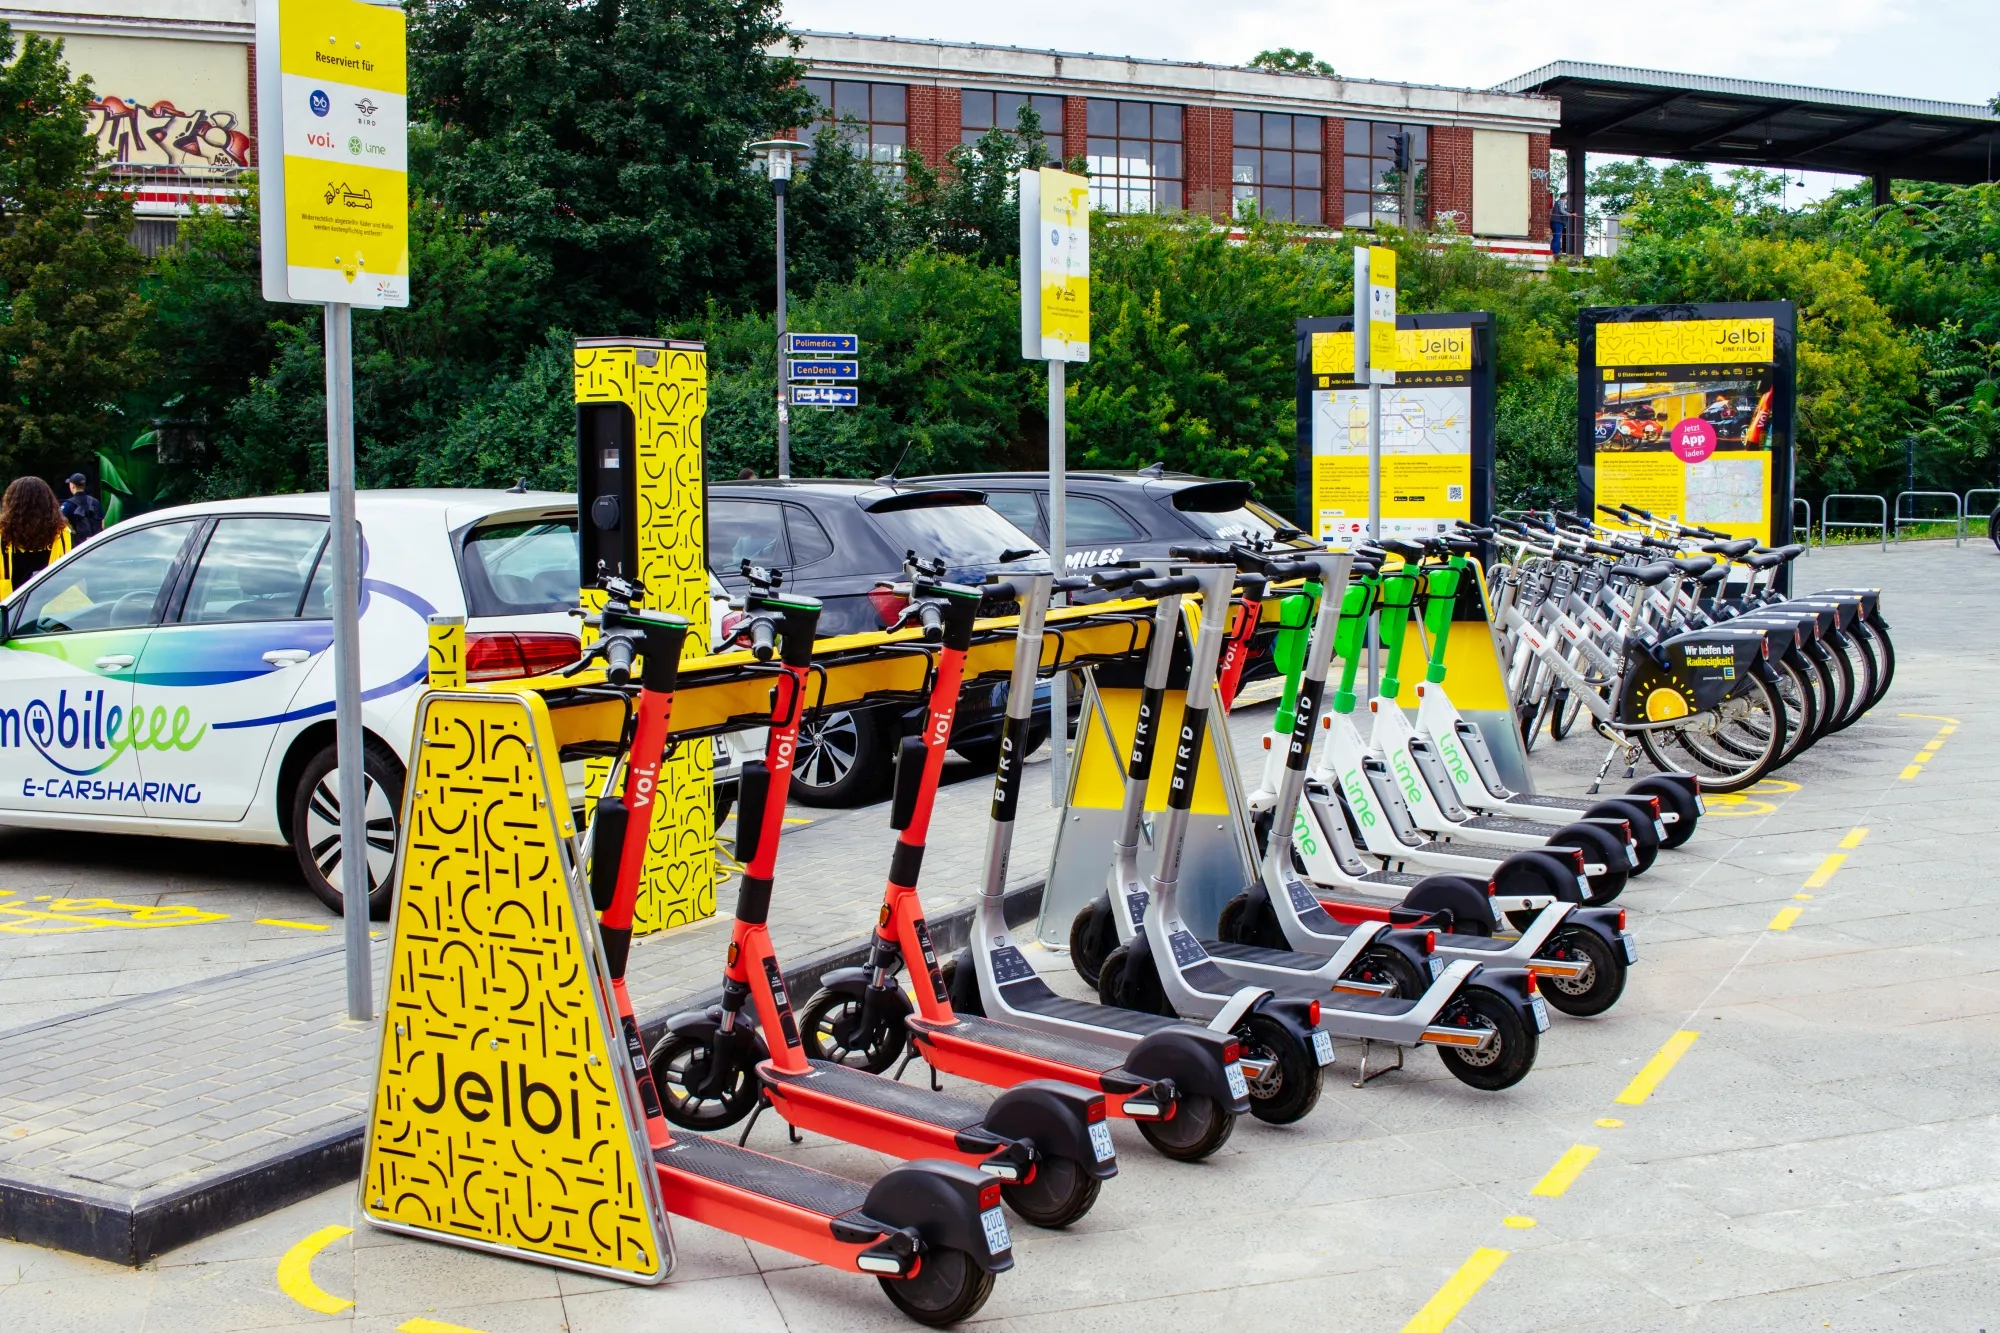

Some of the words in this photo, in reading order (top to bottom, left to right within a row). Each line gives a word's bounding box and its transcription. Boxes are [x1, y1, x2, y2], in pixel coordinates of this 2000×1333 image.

[315, 51, 360, 70] Reserviert
[362, 60, 375, 72] für
[357, 118, 377, 127] BIRD
[307, 132, 335, 149] voi.
[795, 339, 837, 348] Polimedica
[1419, 337, 1464, 353] Jelbi
[1715, 327, 1766, 345] Jelbi
[796, 365, 837, 375] CenDenta
[1683, 424, 1701, 433] Jetzt
[1681, 433, 1705, 449] App
[1684, 448, 1705, 458] laden
[1065, 547, 1124, 570] MILES
[1222, 643, 1239, 671] voi.
[1684, 645, 1698, 656] Wir
[1698, 645, 1722, 655] helfen
[1722, 644, 1735, 655] bei
[1686, 656, 1735, 669] Radlosigkeit!
[1544, 655, 1591, 703] nextbike
[931, 707, 953, 746] voi.
[1132, 703, 1151, 763] BIRD
[1290, 695, 1313, 755] BIRD
[774, 728, 796, 771] voi.
[1172, 724, 1194, 791] BIRD
[1439, 732, 1469, 785] Lime
[993, 734, 1014, 802] BIRD
[1391, 748, 1422, 805] Lime
[22, 778, 202, 804] E-CARSHARING
[633, 762, 656, 808] voi.
[1344, 768, 1376, 828] Lime
[1294, 807, 1317, 856] me
[1314, 1035, 1329, 1048] 836
[1317, 1048, 1333, 1063] VTC
[1228, 1068, 1241, 1079] 664
[412, 1052, 581, 1141] Jelbi
[1230, 1080, 1246, 1097] HZP
[1091, 1126, 1108, 1142] 946
[1095, 1142, 1113, 1160] HZJ
[984, 1211, 1002, 1232] 200
[988, 1230, 1009, 1251] HZG
